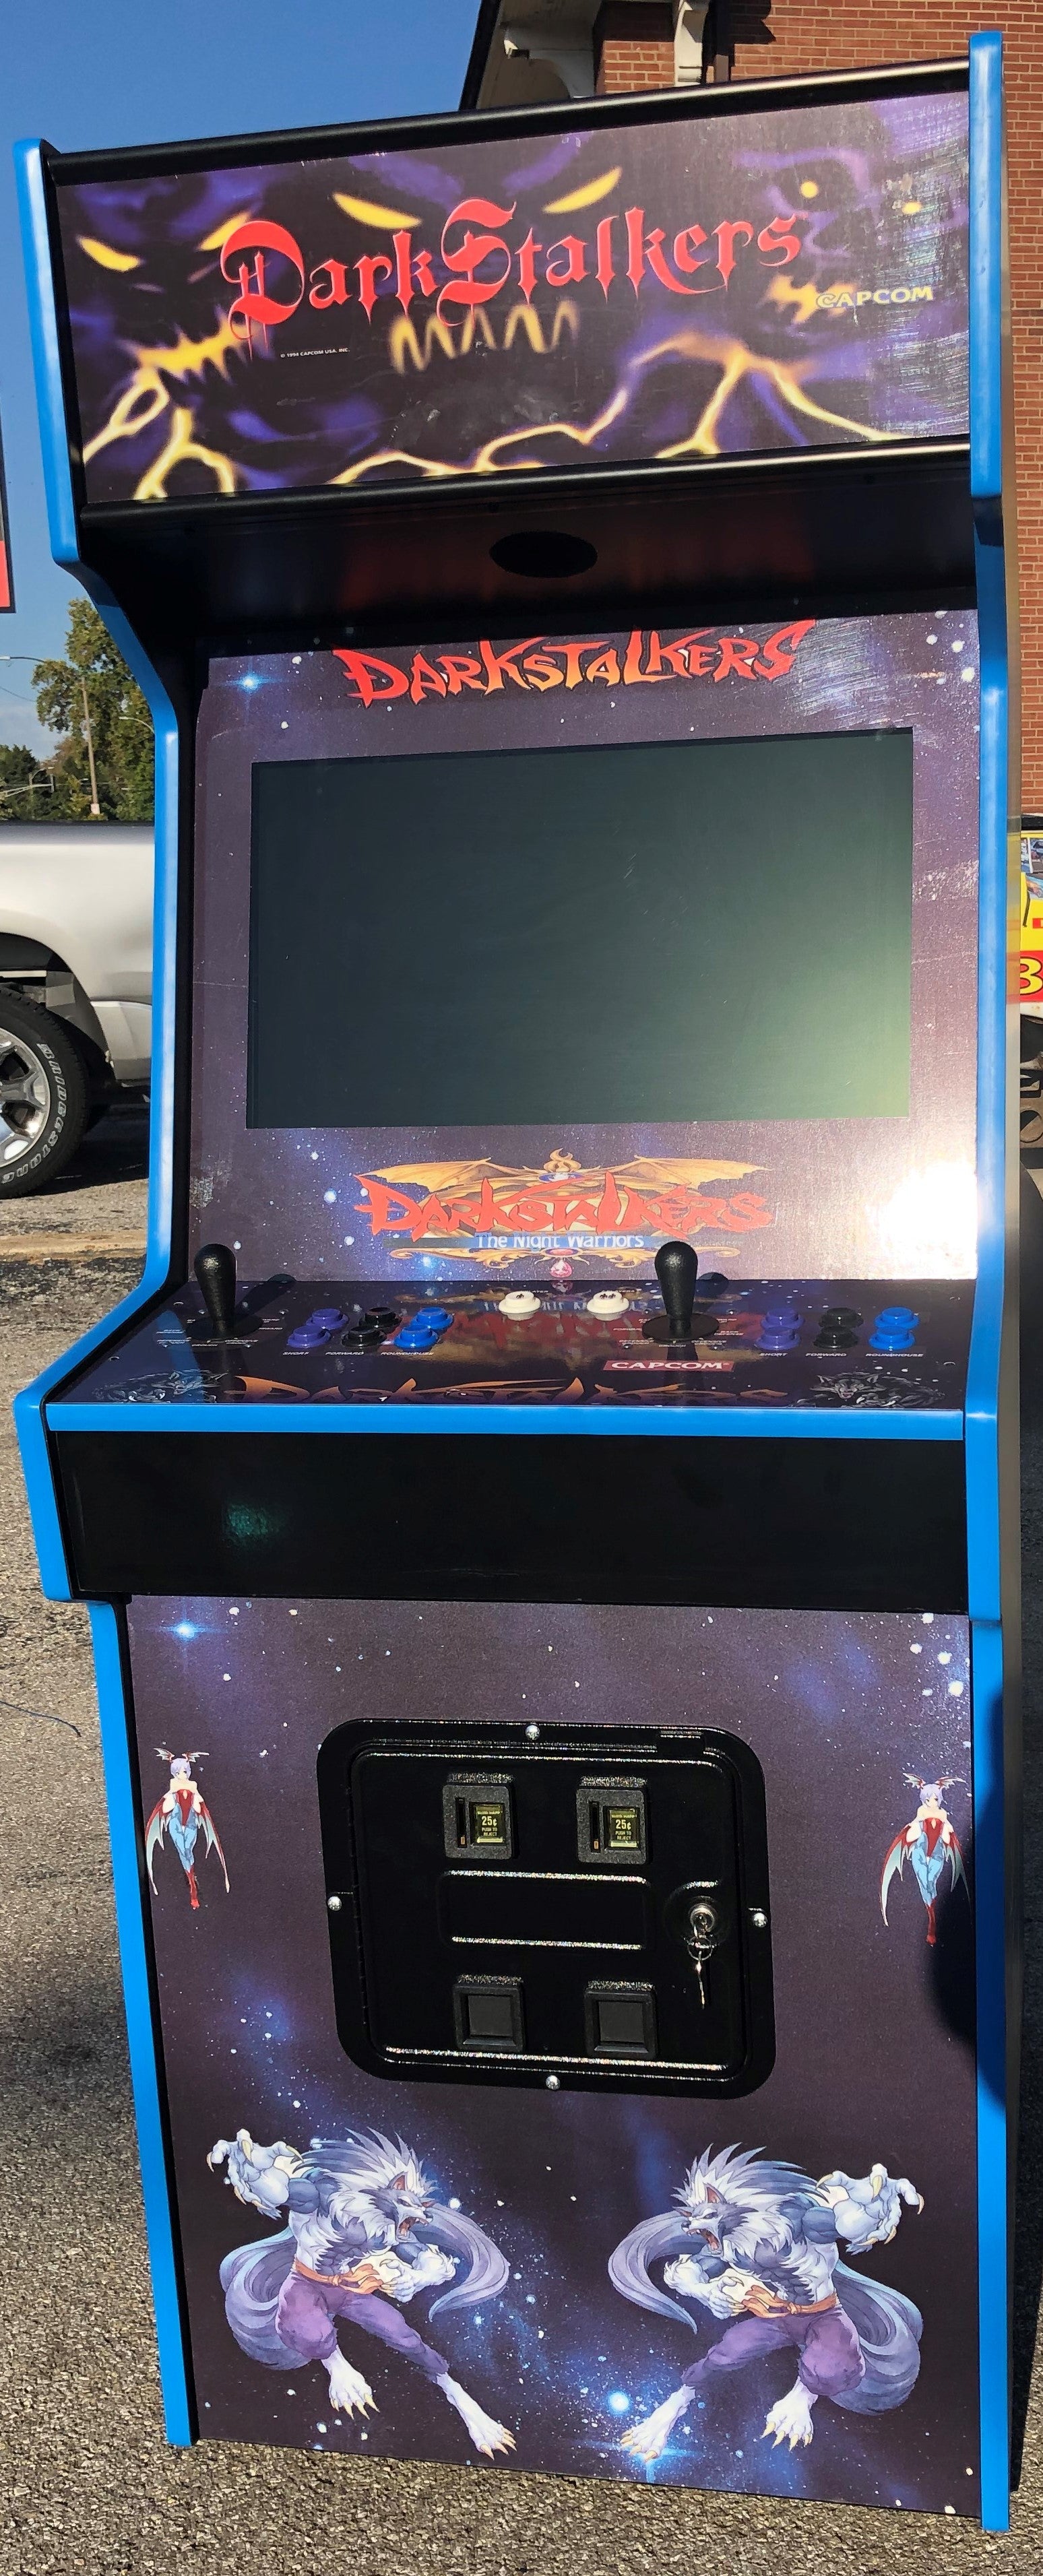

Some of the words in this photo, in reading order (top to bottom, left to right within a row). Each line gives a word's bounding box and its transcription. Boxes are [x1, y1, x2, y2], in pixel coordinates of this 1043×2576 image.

[817, 286, 934, 309] CAPCOM
[334, 618, 816, 707] DARKSTALKERS
[354, 1171, 774, 1242] DARKSTALKERS
[478, 1235, 508, 1248] The
[513, 1235, 561, 1251] Night
[567, 1234, 645, 1248] Warriors
[611, 1361, 723, 1370] CAPCOM
[481, 1815, 497, 1826] 25¢
[615, 1819, 631, 1830] 25¢
